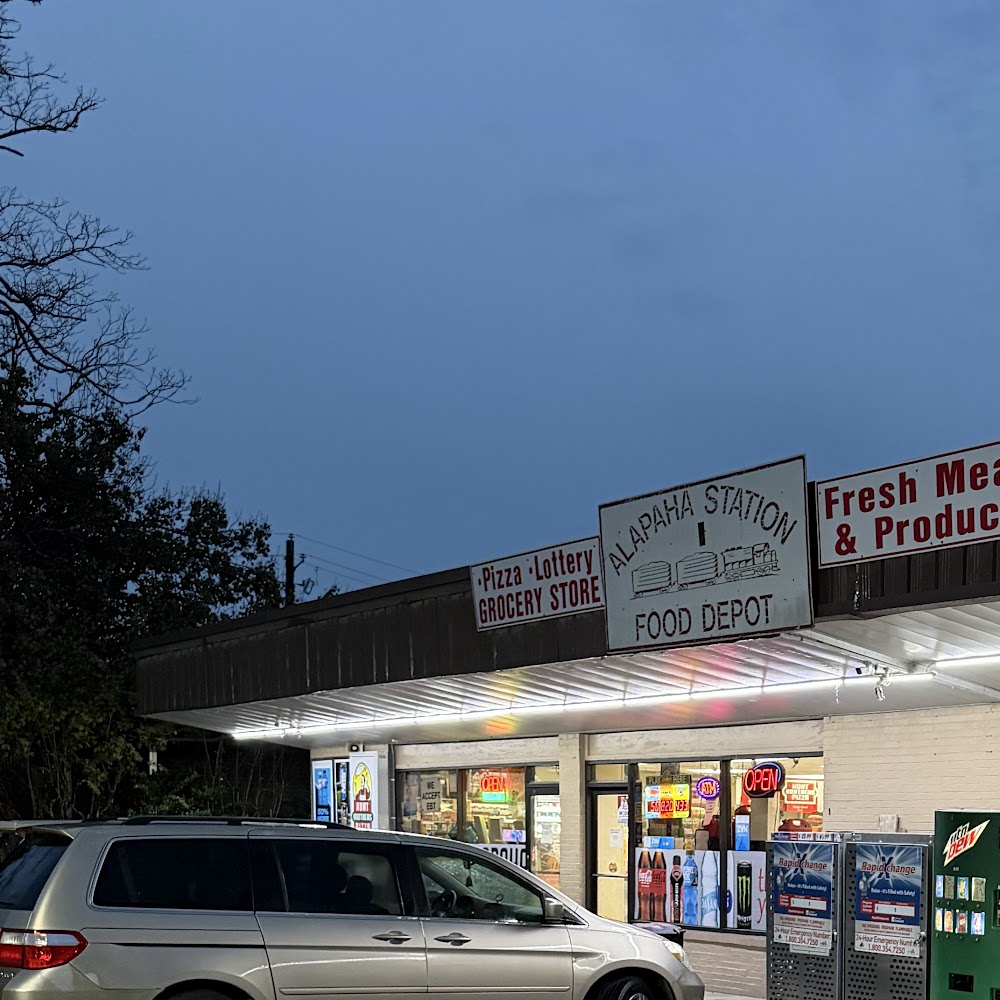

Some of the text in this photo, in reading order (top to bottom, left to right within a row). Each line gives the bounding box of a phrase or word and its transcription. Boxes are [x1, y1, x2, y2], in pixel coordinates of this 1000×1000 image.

[824, 469, 917, 520] Fresh
[608, 484, 797, 576] ALAPAHA STATION
[834, 523, 858, 556] &
[482, 549, 593, 592] Pizza Lottery
[479, 575, 601, 624] GROCERY STORE
[635, 594, 773, 641] FOOD DEPOT
[426, 781, 435, 790] WE
[482, 776, 505, 792] OPEN
[700, 781, 715, 795] ATM
[744, 768, 778, 792] OPEN
[422, 792, 441, 800] ACCEPT
[426, 802, 436, 811] EBT
[774, 926, 831, 939] 24-Hour Emergency Number
[856, 934, 873, 942] 24-Hour
[874, 936, 900, 946] Emergency
[868, 944, 906, 954] 1.800.354.7250
